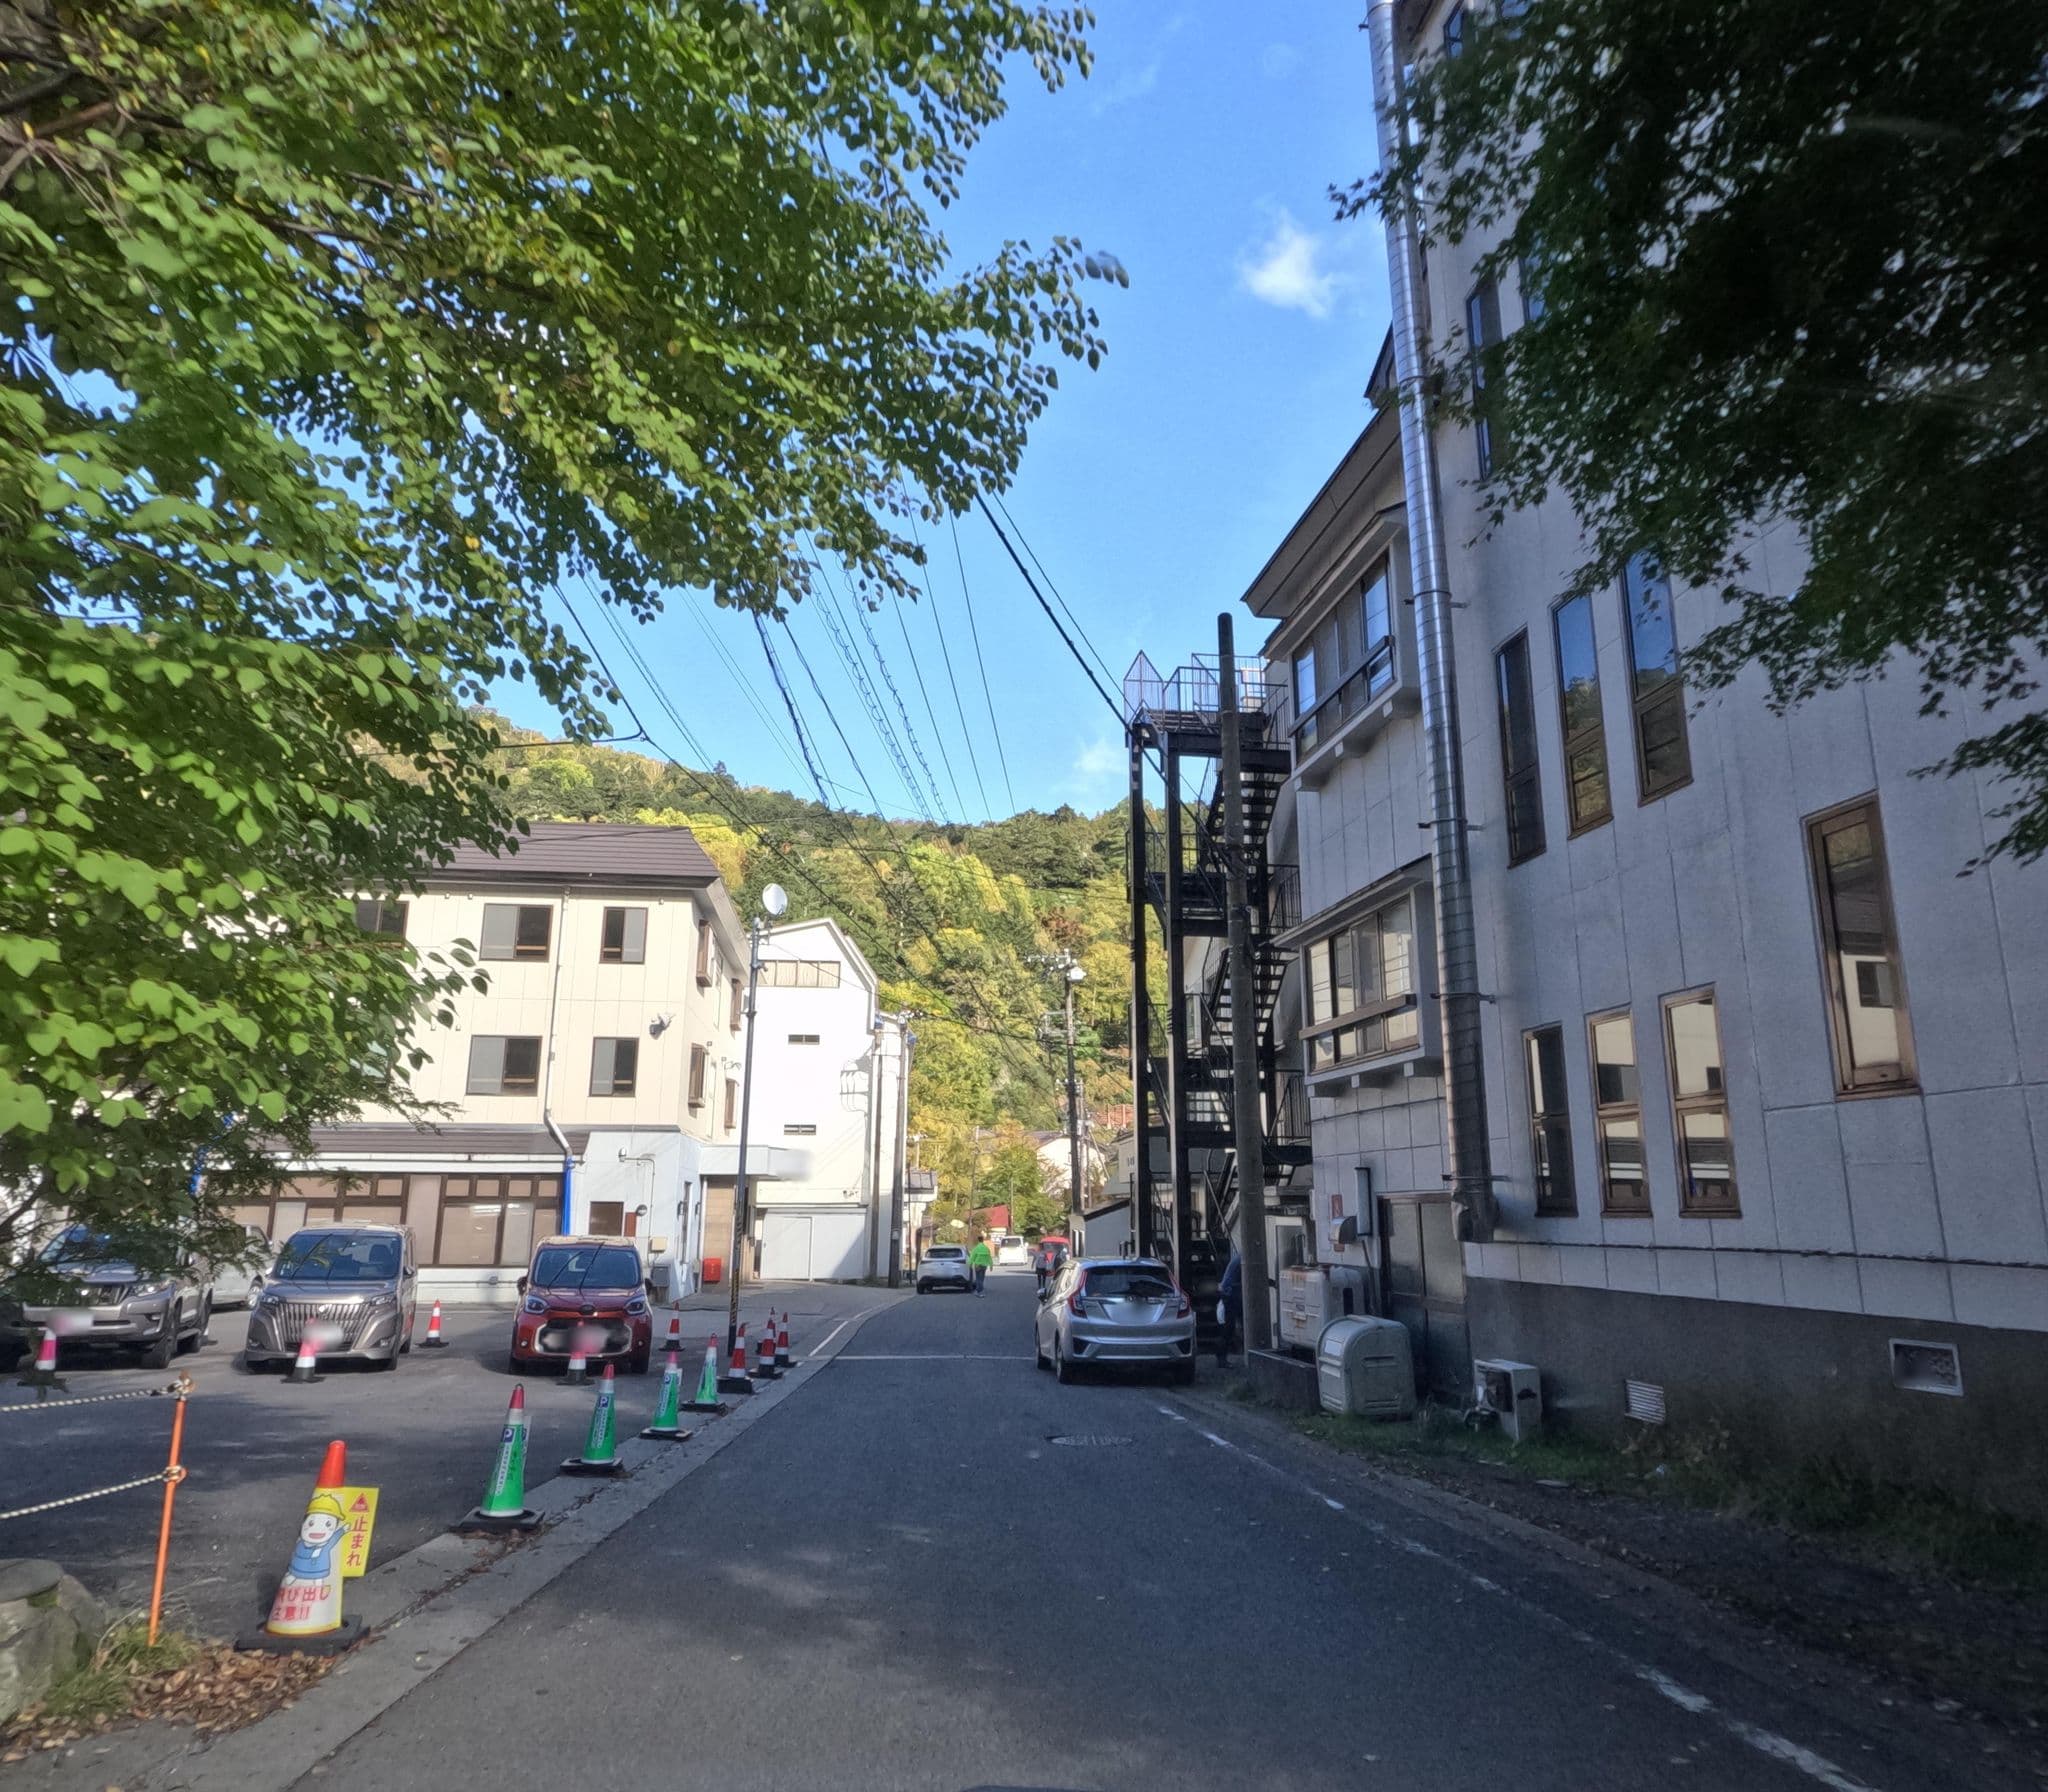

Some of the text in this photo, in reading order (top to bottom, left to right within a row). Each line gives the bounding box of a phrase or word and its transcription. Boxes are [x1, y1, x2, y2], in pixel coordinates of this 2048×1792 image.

[503, 1429, 512, 1443] P
[346, 1515, 369, 1567] 止まれ
